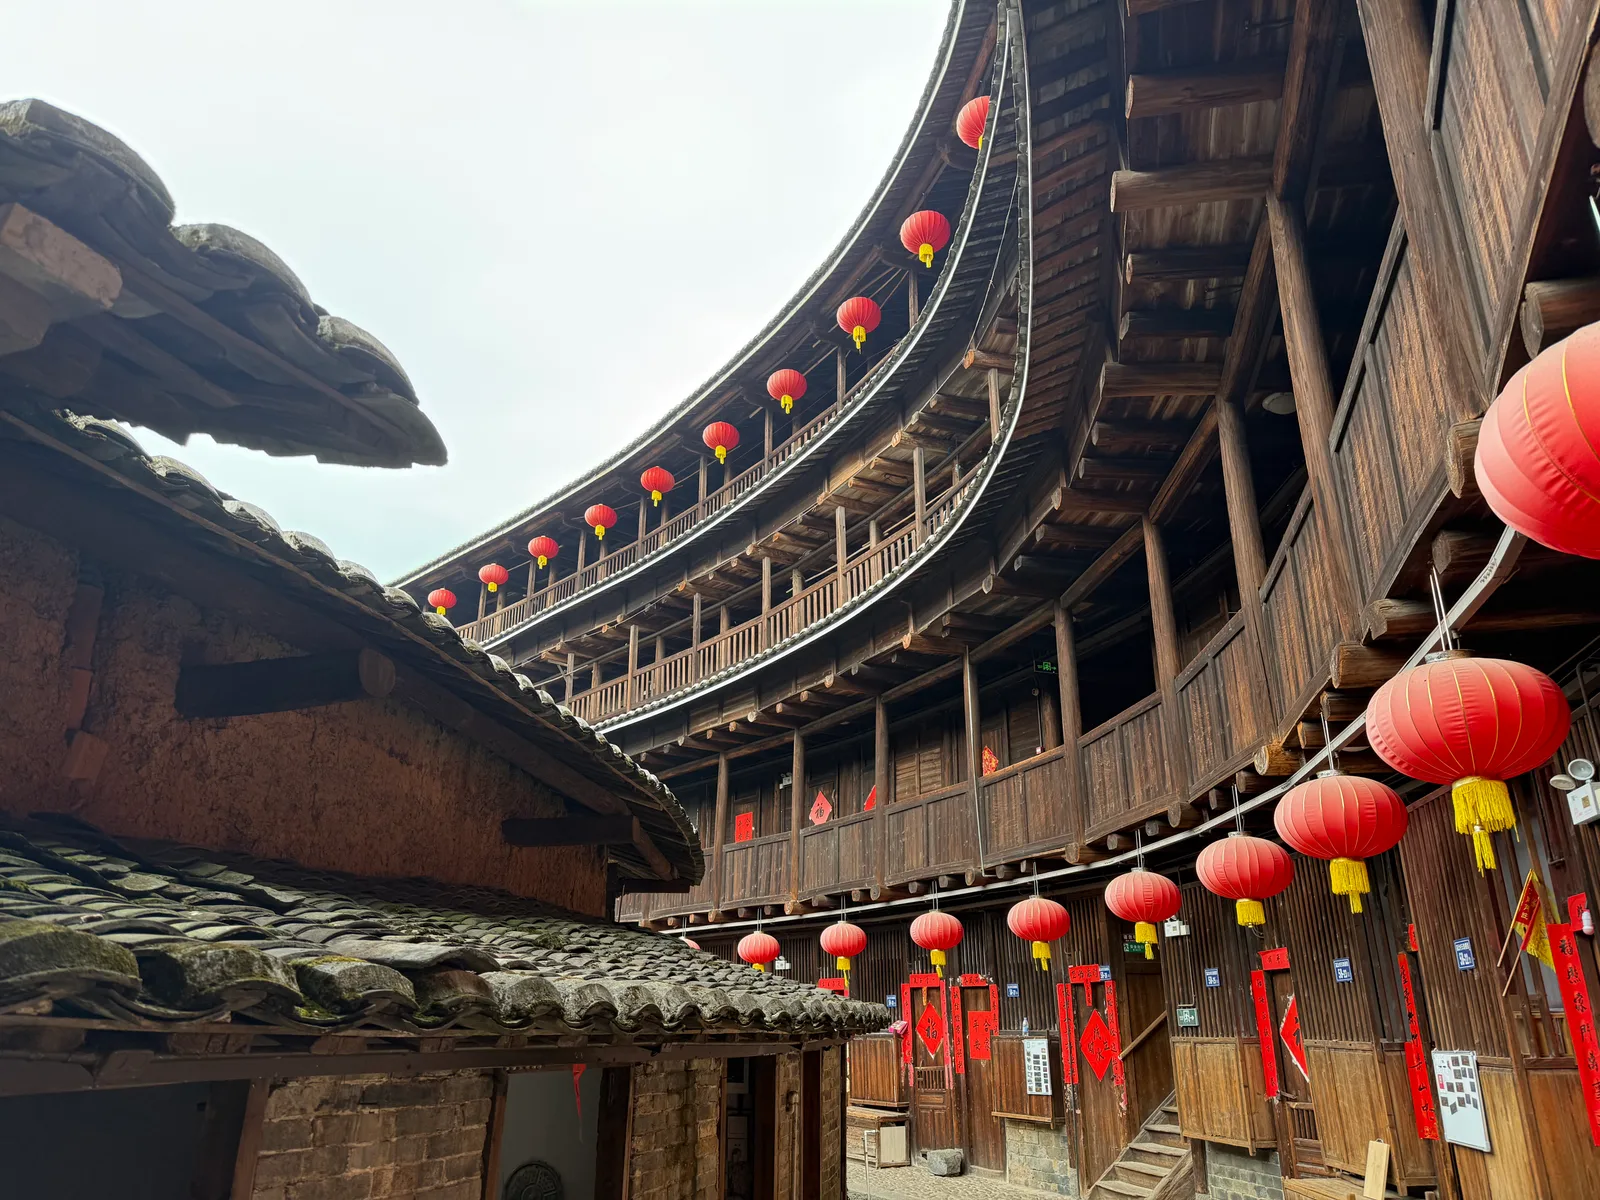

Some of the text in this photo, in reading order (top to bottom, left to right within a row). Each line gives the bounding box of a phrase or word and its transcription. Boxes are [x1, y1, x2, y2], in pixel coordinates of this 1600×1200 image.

[815, 802, 825, 819] 福
[925, 1017, 938, 1040] 福
[972, 1018, 981, 1051] 平安
